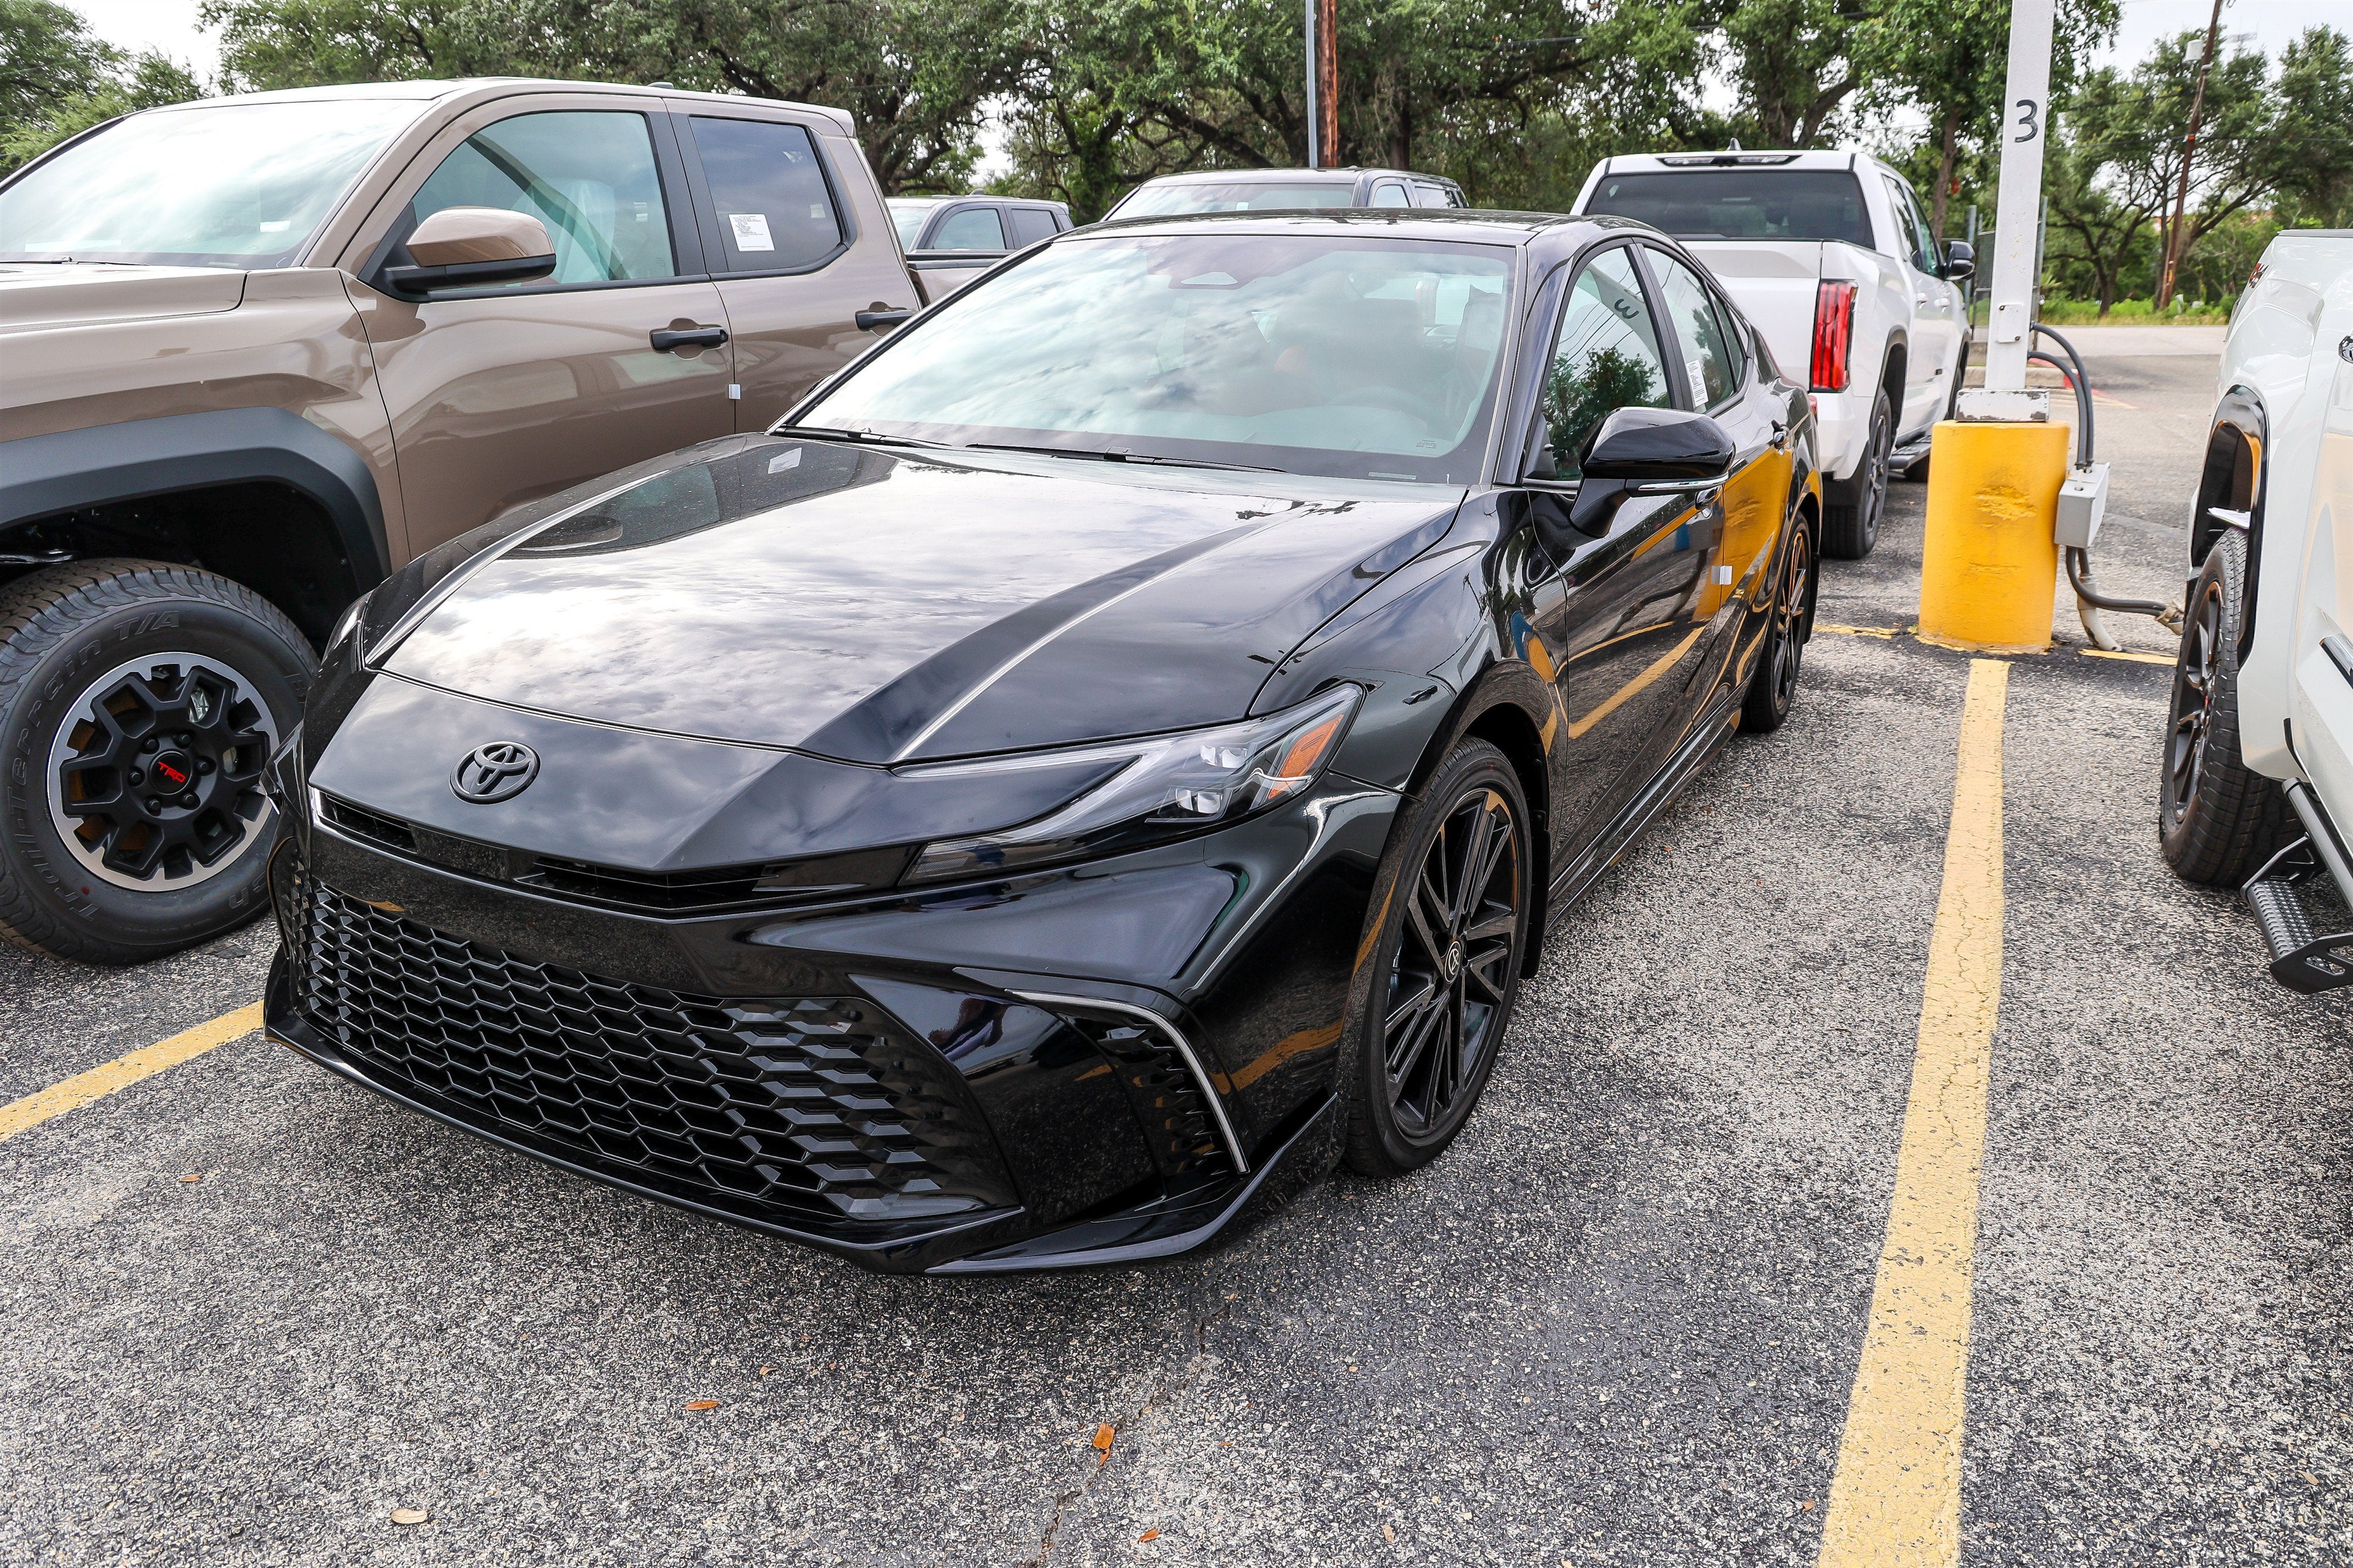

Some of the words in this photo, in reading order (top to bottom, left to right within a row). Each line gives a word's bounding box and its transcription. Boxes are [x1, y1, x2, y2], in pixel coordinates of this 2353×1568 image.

[2014, 99, 2038, 143] 3
[113, 610, 180, 642] T/A
[158, 761, 186, 783] TRD
